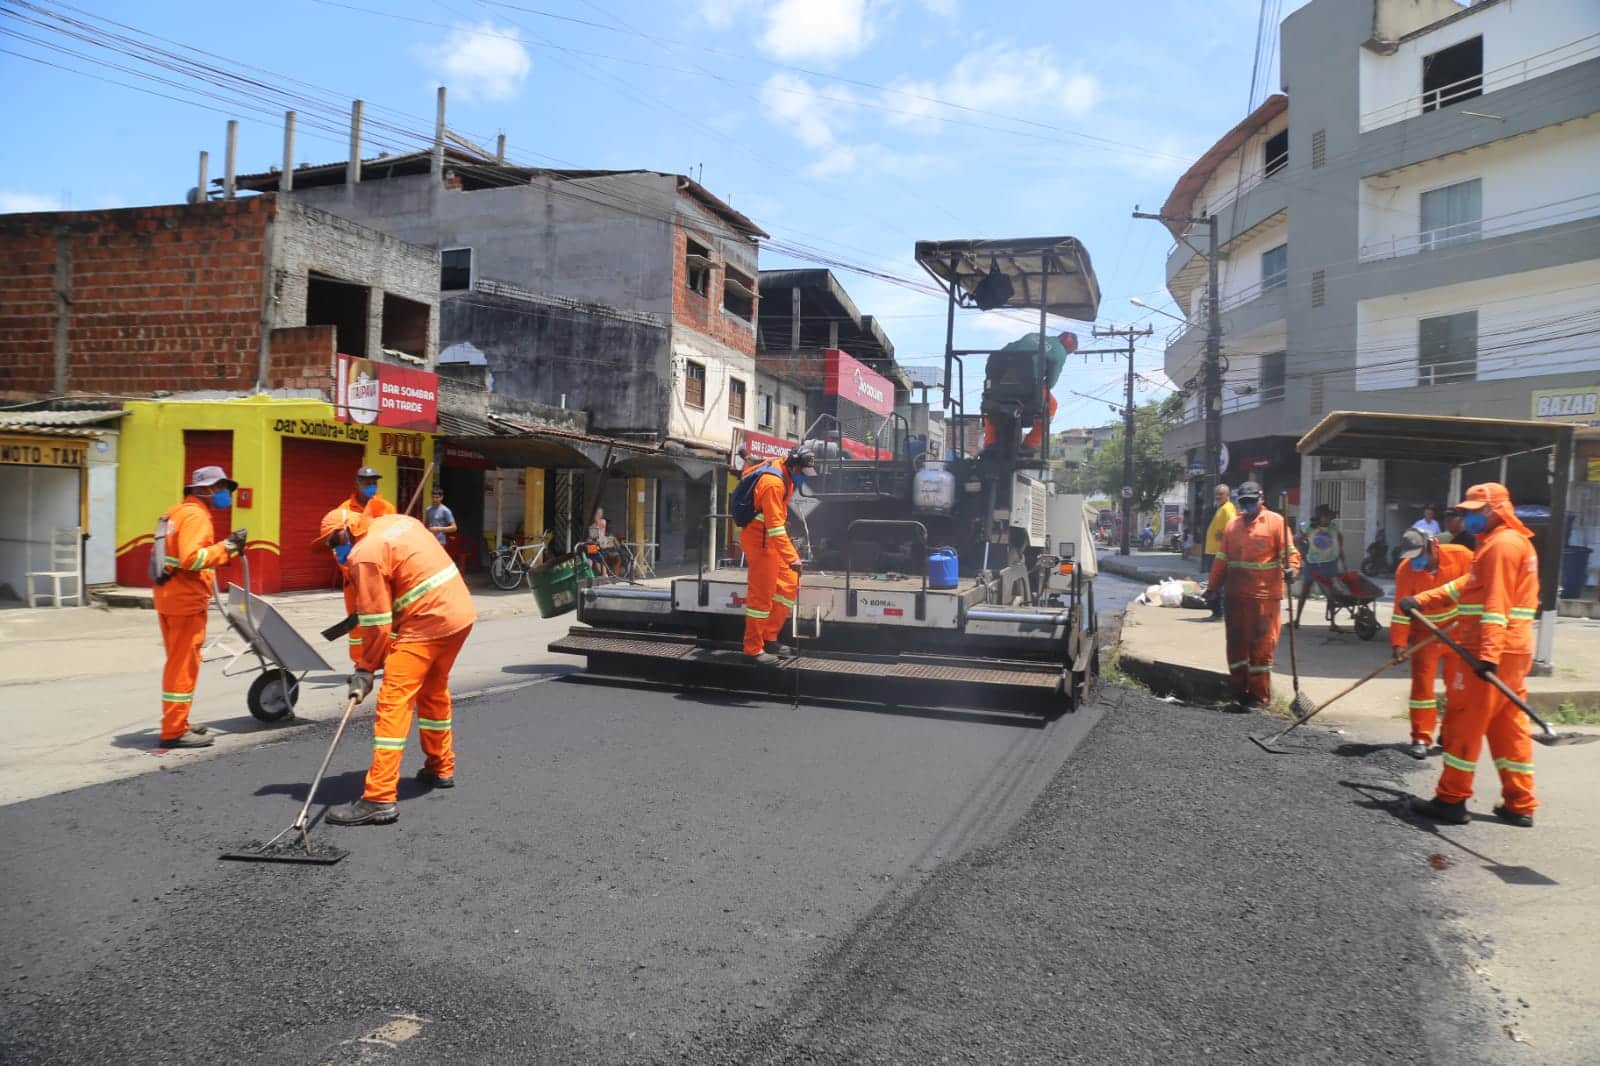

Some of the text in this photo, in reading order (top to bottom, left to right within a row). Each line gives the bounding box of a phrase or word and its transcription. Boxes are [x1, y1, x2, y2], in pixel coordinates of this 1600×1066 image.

[382, 383, 435, 401] BAR SOMBRA
[382, 397, 423, 413] DA TARDE
[1537, 393, 1596, 416] BAZAR
[344, 422, 369, 442] Tarde
[1, 445, 40, 463] MOTO
[52, 447, 86, 464] TAXI
[751, 440, 761, 451] BAR
